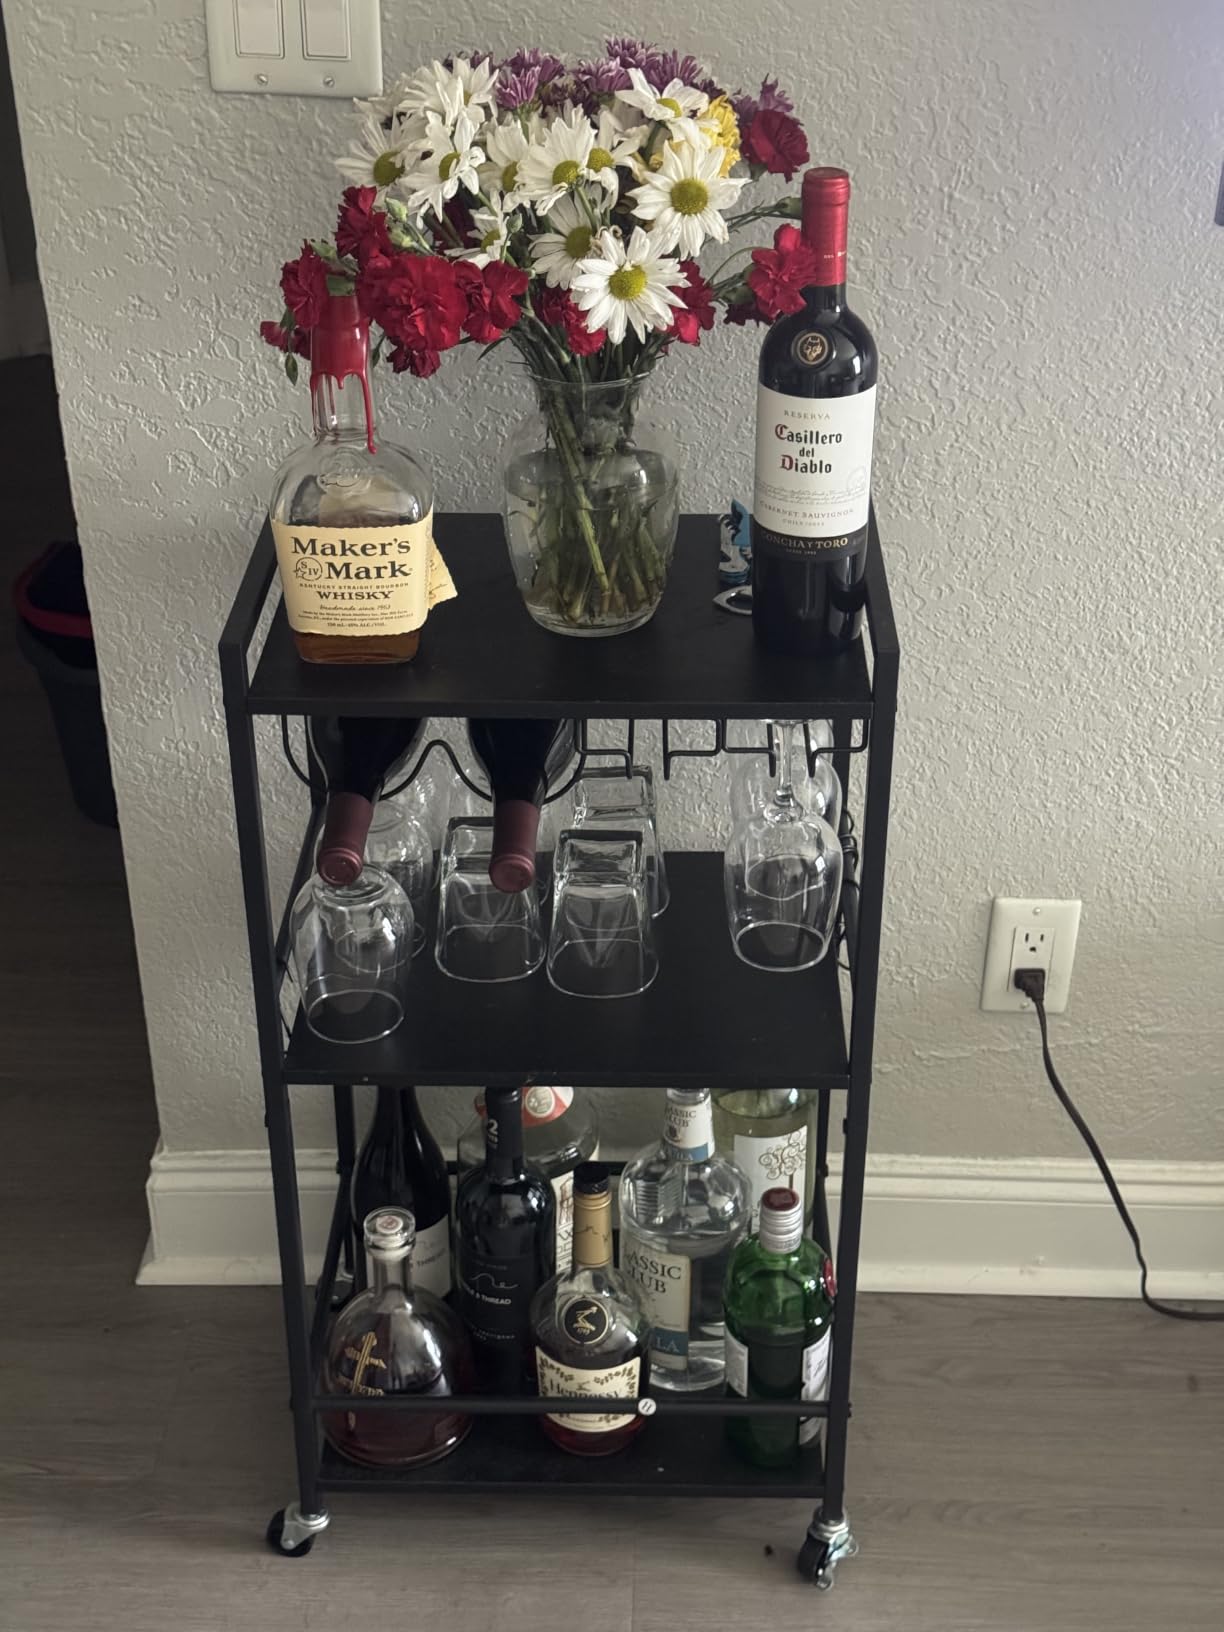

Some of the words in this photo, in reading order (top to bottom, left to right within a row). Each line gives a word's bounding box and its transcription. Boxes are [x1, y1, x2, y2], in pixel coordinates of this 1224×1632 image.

[784, 409, 831, 421] RESERVA
[774, 423, 843, 445] Casillero
[799, 446, 815, 458] del
[780, 454, 833, 474] Diablo
[291, 536, 411, 557] Maker's
[765, 532, 806, 548] ONCHA
[807, 541, 813, 549] Y
[814, 536, 849, 549] TORO
[300, 561, 308, 569] S
[308, 568, 319, 576] IV
[325, 560, 412, 580] Mark
[299, 582, 336, 590] KENTUCKY
[375, 582, 409, 590] BOURBON
[316, 590, 395, 601] WHISKY
[628, 1250, 682, 1280] ASSIC
